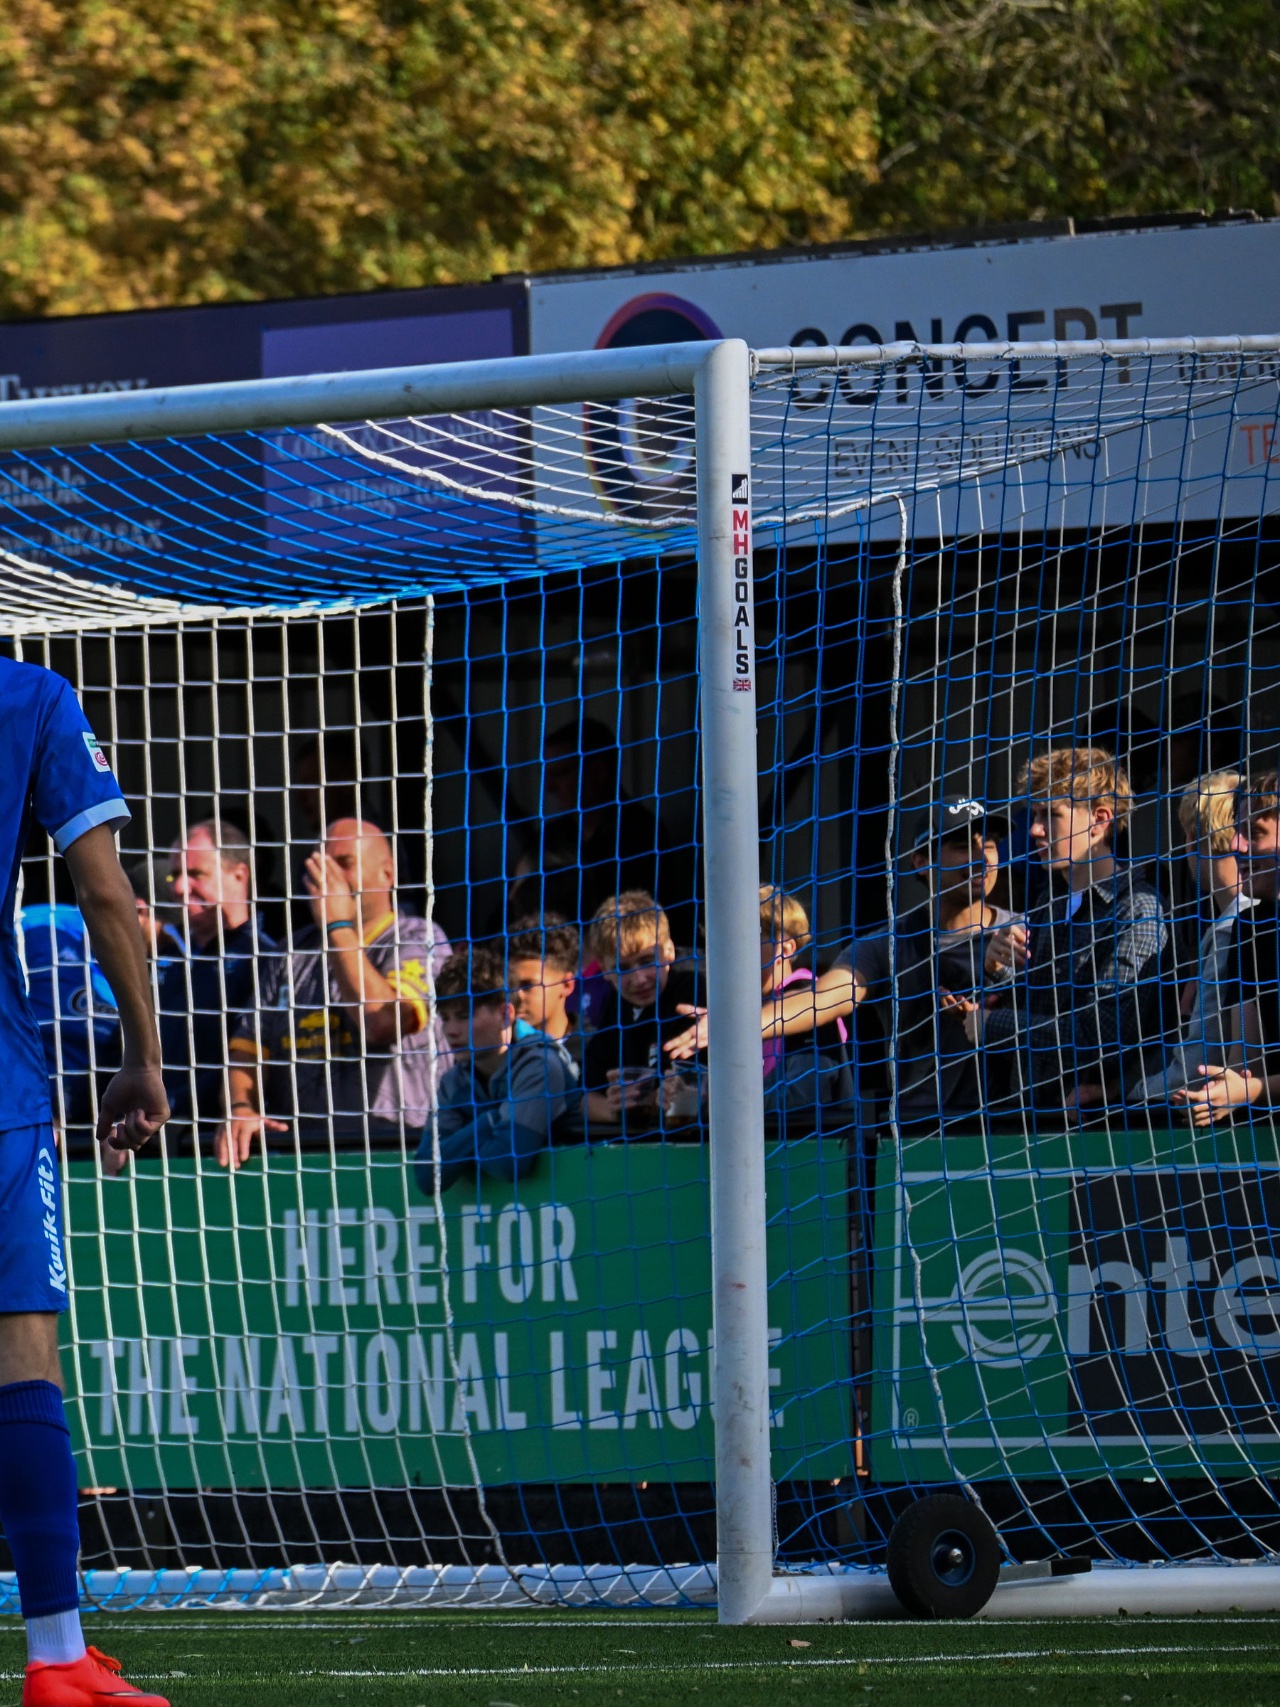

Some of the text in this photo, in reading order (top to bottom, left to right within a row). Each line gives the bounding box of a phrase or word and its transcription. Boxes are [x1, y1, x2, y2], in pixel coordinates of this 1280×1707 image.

[787, 302, 1143, 411] CONCEPT
[834, 436, 927, 478] EVEN
[282, 1203, 579, 1307] HERE FOR
[90, 1326, 785, 1437] THE NATIONAL LEAGE
